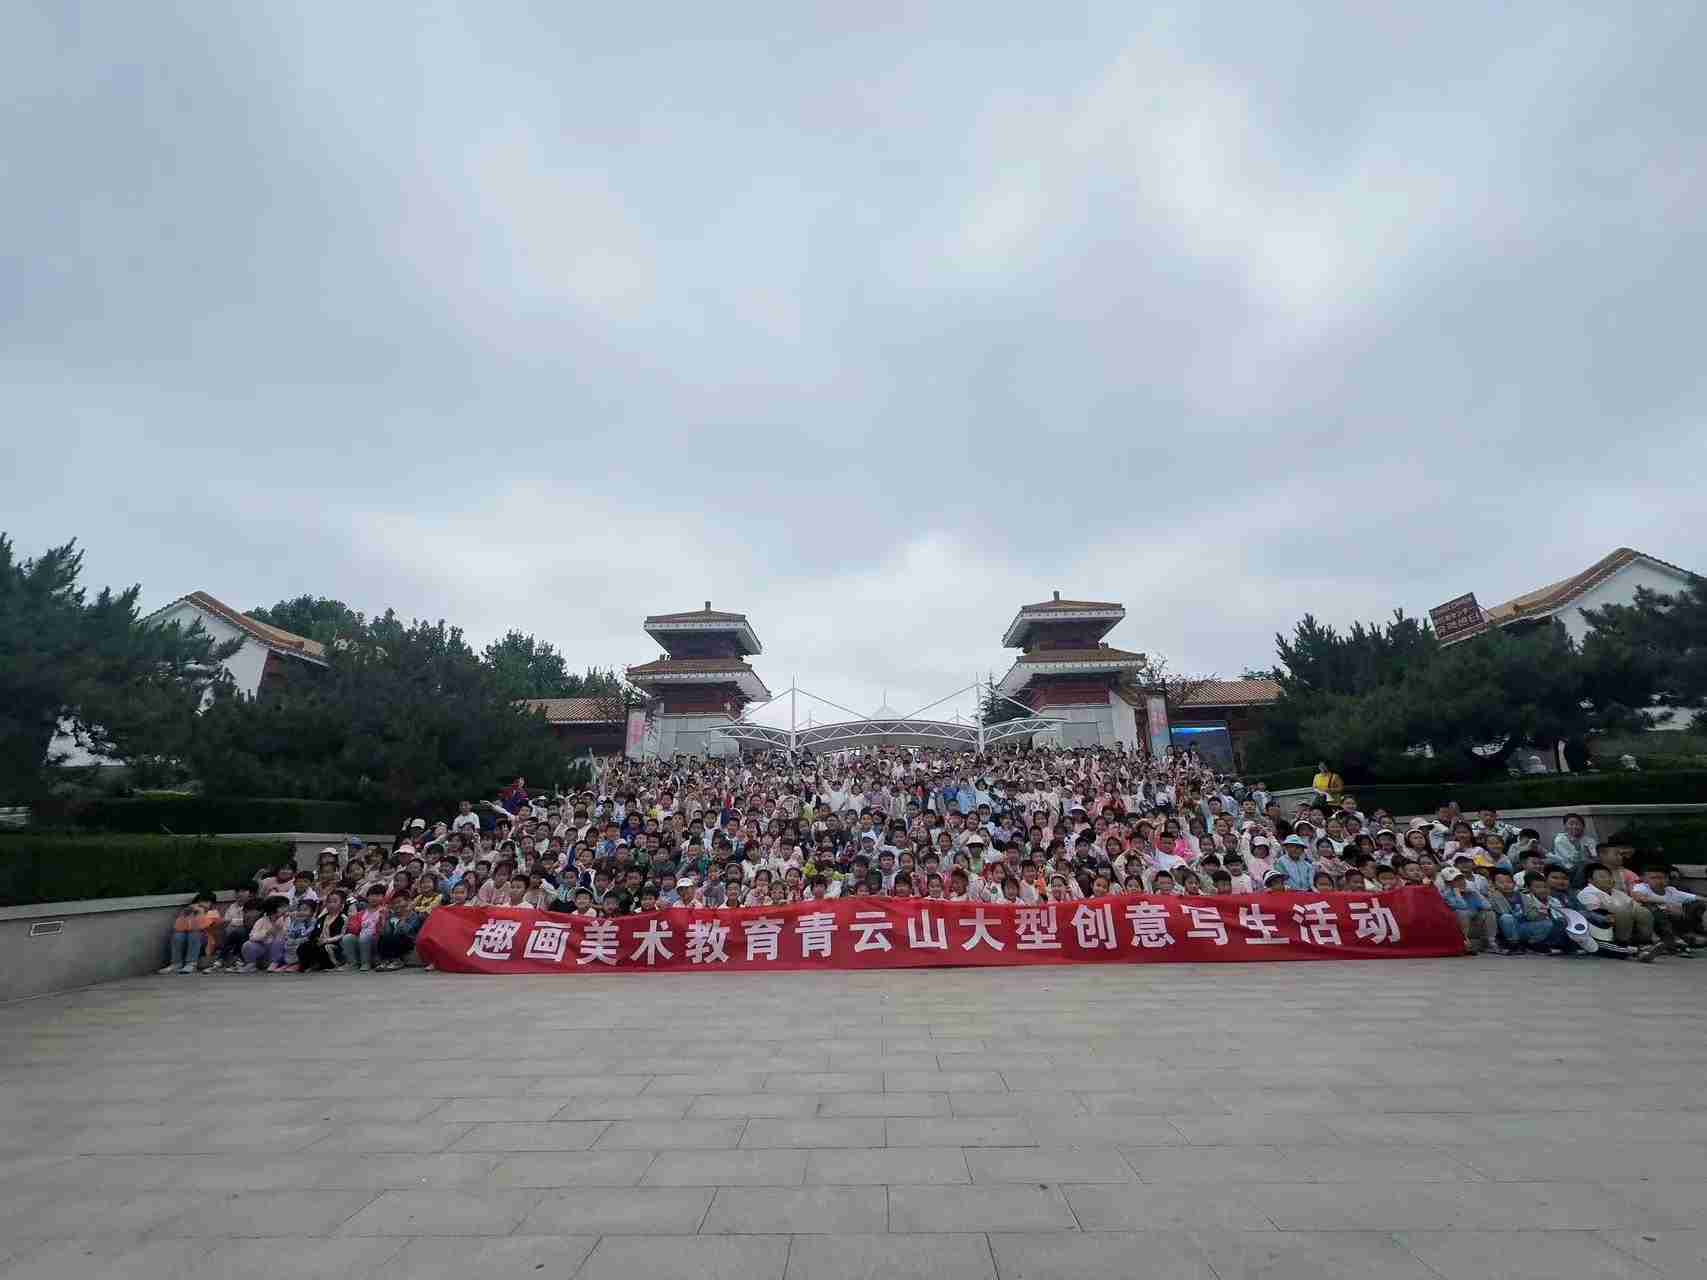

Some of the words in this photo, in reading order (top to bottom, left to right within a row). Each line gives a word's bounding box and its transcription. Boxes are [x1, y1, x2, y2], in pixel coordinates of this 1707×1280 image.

[465, 897, 1401, 965] 趣画美术教育青云山大型创意写生活动
